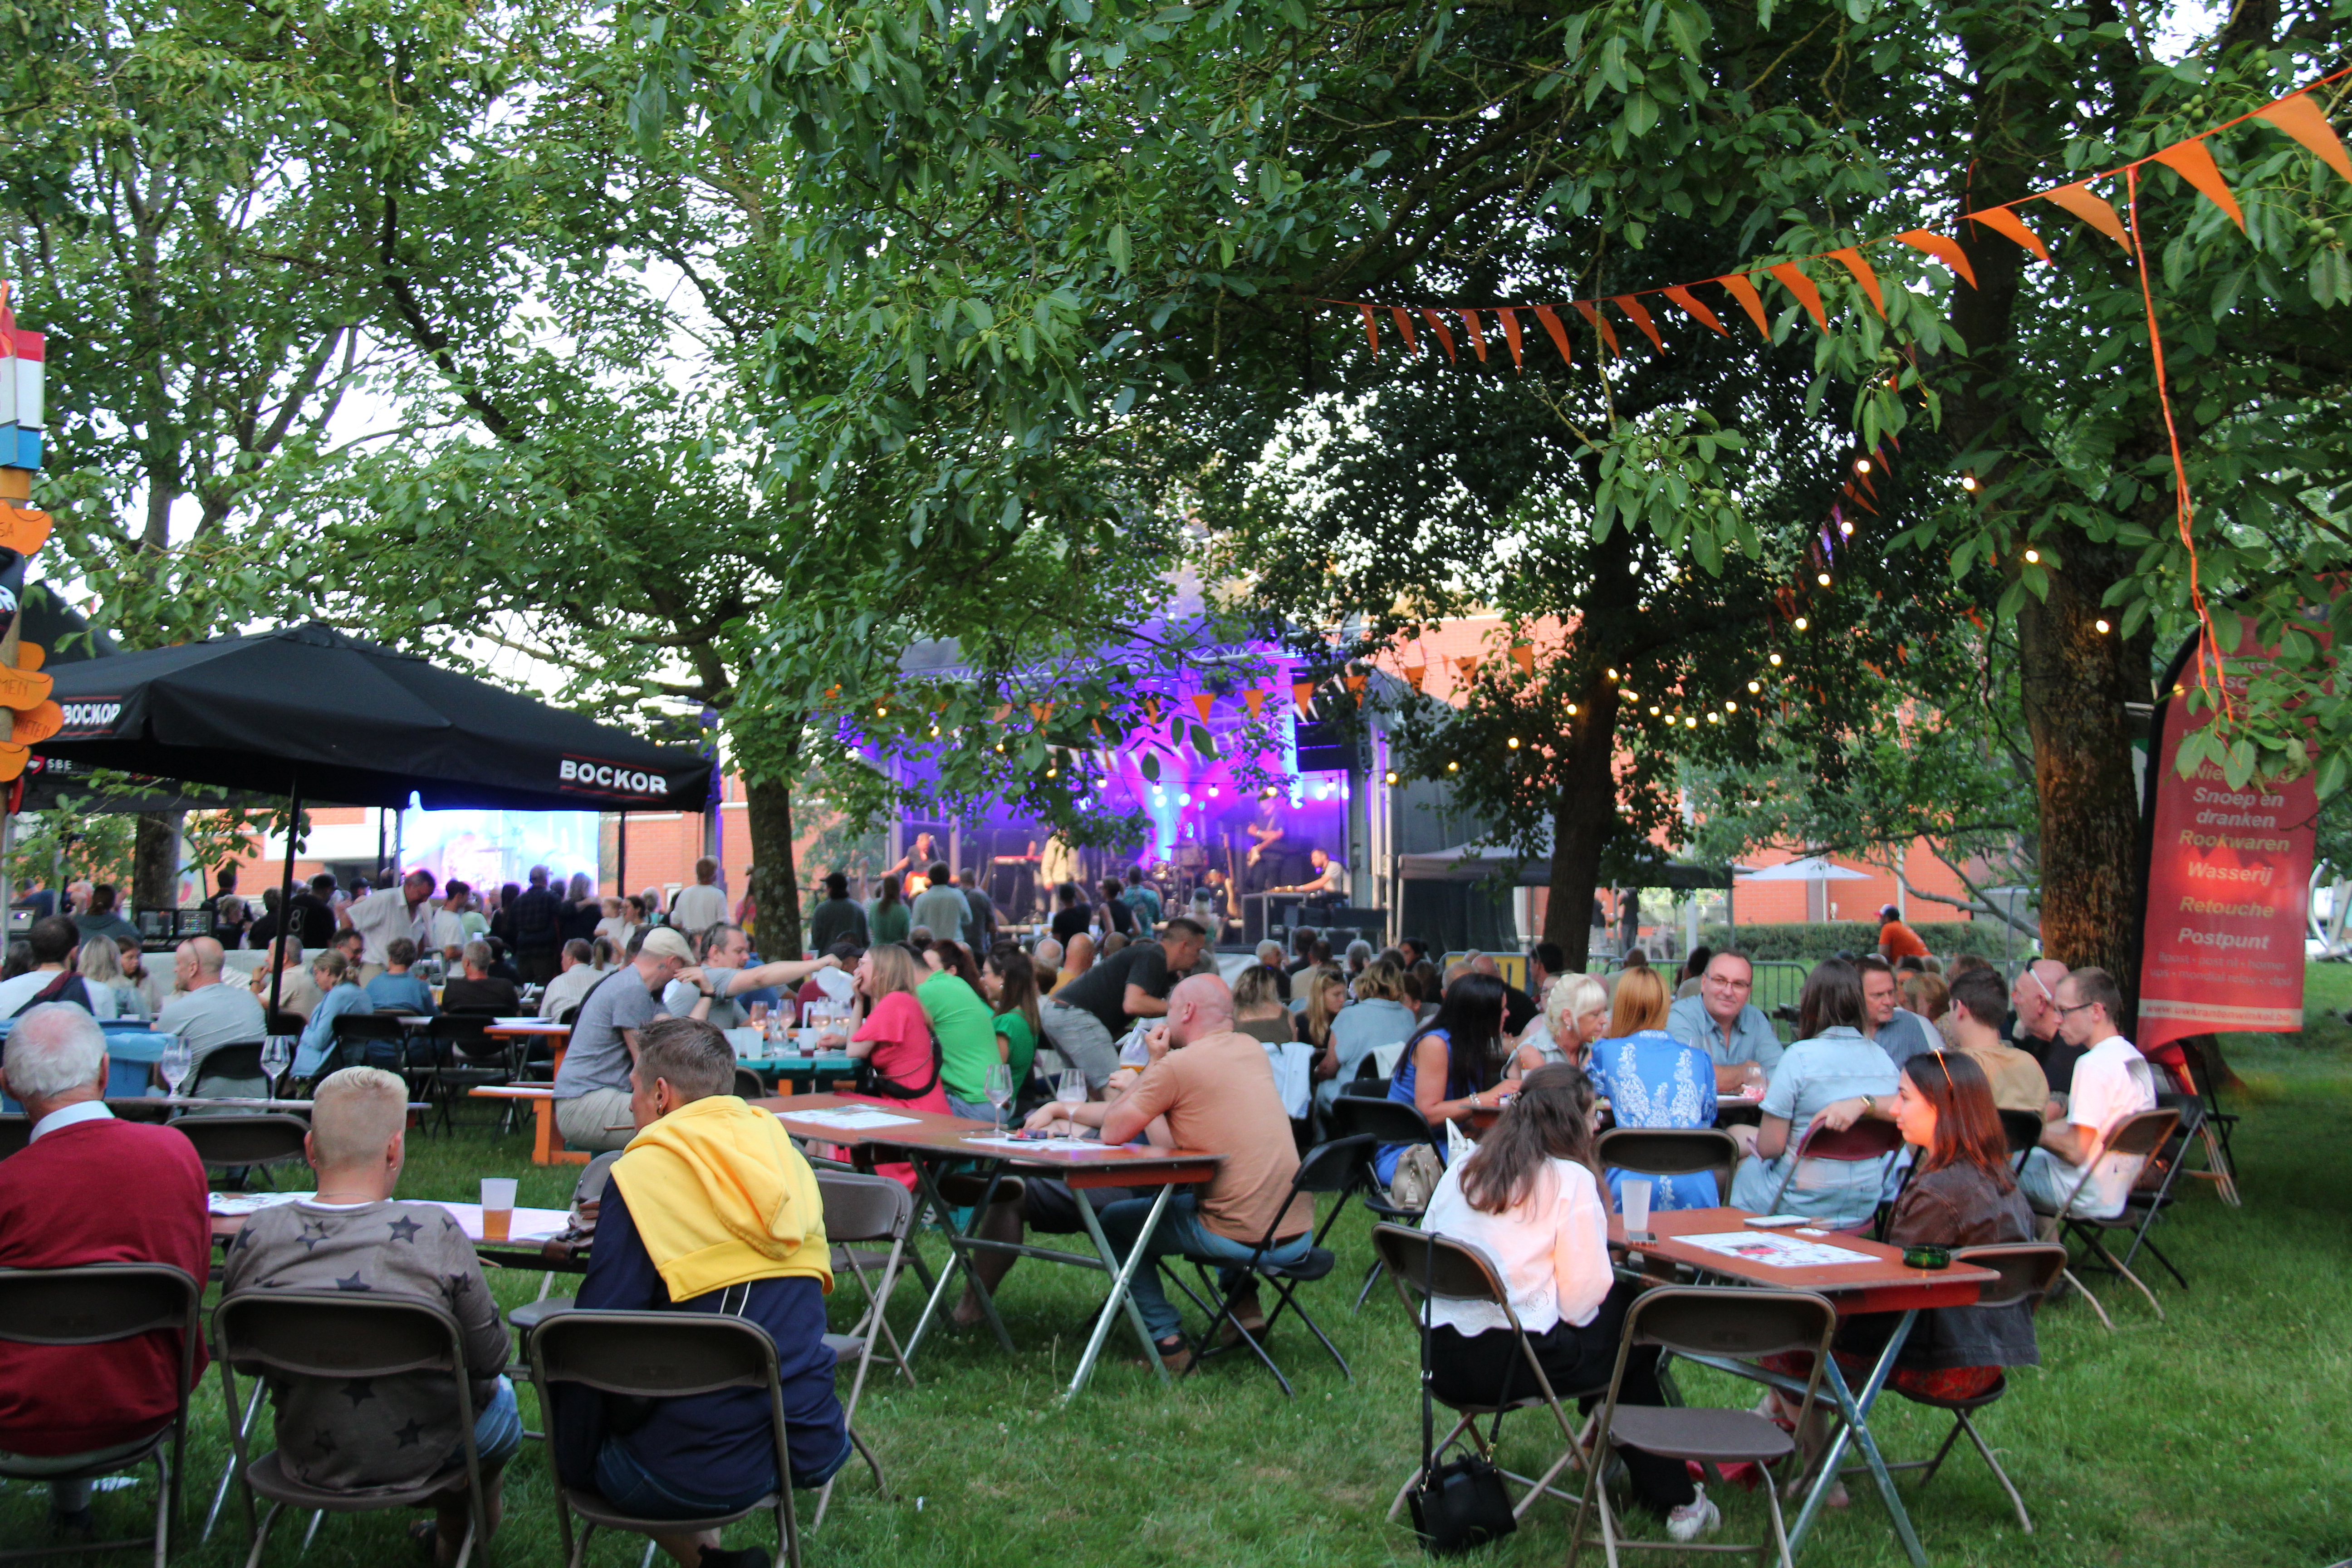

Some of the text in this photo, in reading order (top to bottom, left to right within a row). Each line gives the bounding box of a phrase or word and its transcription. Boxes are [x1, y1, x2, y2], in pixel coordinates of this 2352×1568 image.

[559, 760, 668, 794] BOCKOR
[2193, 787, 2284, 808] Snoep en
[2196, 808, 2275, 828] dranken
[2179, 829, 2290, 852] Rookwaren
[2187, 861, 2274, 887] Wasserij
[2179, 896, 2275, 917] Retouche
[2178, 927, 2270, 950] Postpunt
